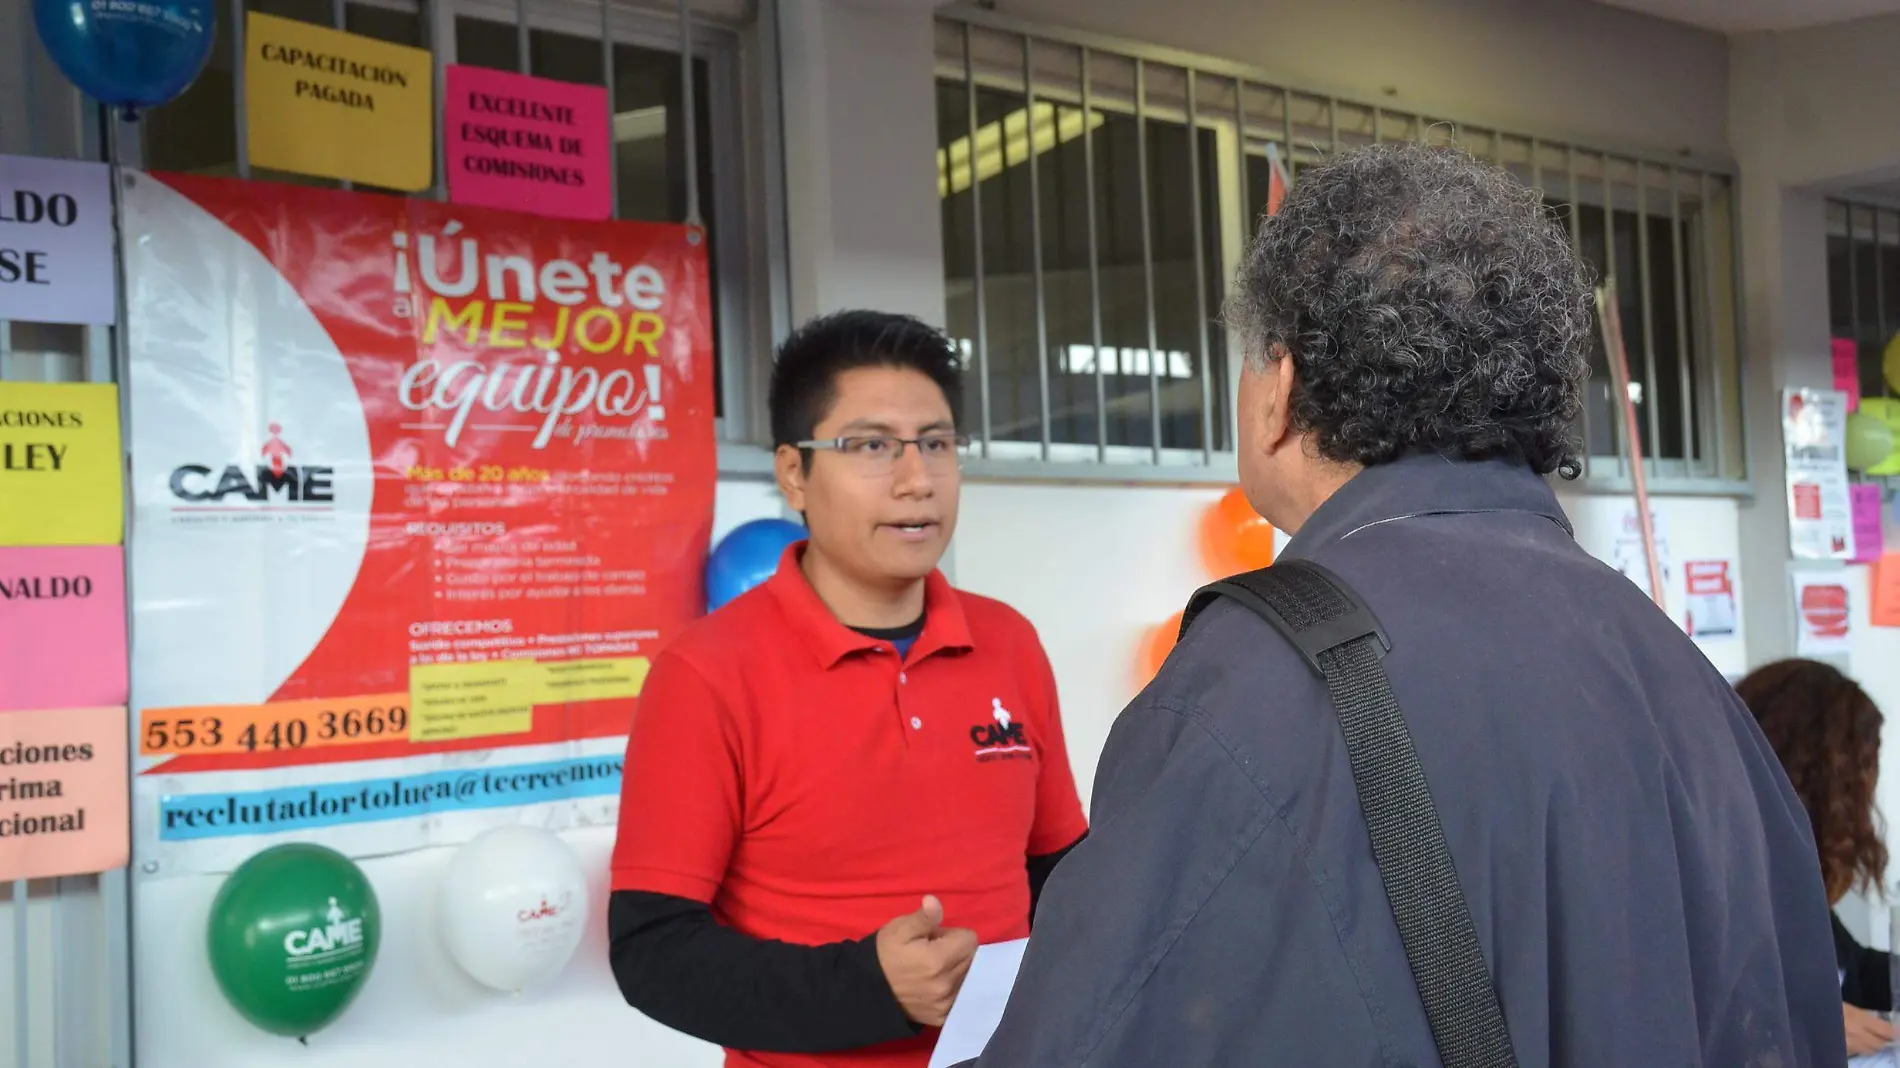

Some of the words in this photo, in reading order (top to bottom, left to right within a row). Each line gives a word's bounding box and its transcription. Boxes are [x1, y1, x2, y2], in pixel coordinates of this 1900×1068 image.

[261, 44, 408, 88] CAPACITACIÓN
[295, 80, 375, 111] PAGADA
[469, 91, 576, 125] EXCELENTE
[461, 122, 553, 153] ESQUEMA
[559, 136, 584, 157] DE
[464, 155, 584, 187] COMISIONES
[0, 248, 51, 285] SE
[393, 219, 665, 310] ¡Únete
[423, 296, 665, 356] MEJOR
[399, 350, 666, 450] equipo!
[0, 409, 83, 428] CIONES
[5, 443, 68, 471] LEY
[448, 467, 476, 481] de
[480, 465, 504, 481] 20
[170, 464, 334, 501] CAME
[409, 619, 513, 637] OFRECEMOS
[145, 717, 224, 750] 553
[238, 718, 308, 751] 440
[317, 706, 408, 741] 3669
[971, 722, 1026, 746] CAME
[0, 742, 93, 765] ciones
[0, 808, 85, 837] cional
[284, 918, 363, 957] CAME
